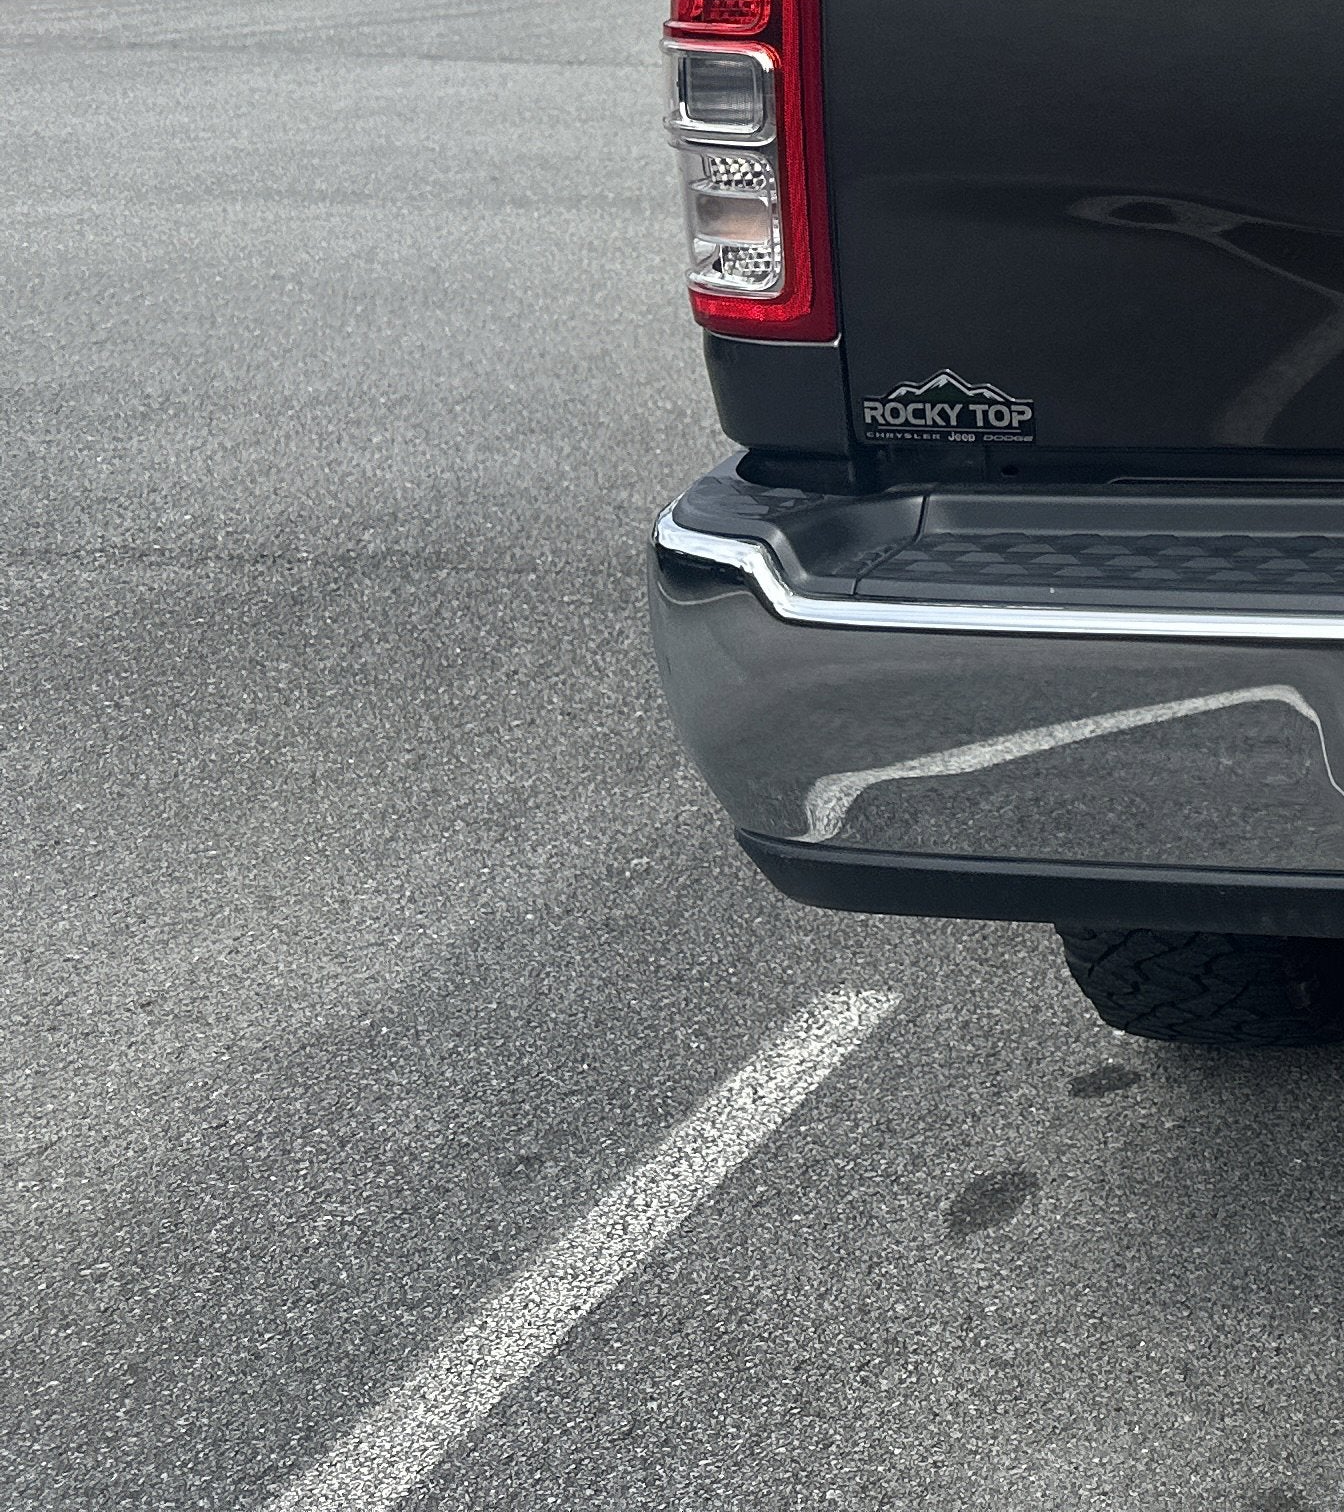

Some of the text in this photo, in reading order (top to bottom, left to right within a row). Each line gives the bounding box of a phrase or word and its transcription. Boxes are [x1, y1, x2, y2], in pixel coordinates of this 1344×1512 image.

[863, 400, 1033, 428] ROCKY TOP
[866, 431, 941, 440] CHRYSLER
[948, 431, 976, 442] Jeep
